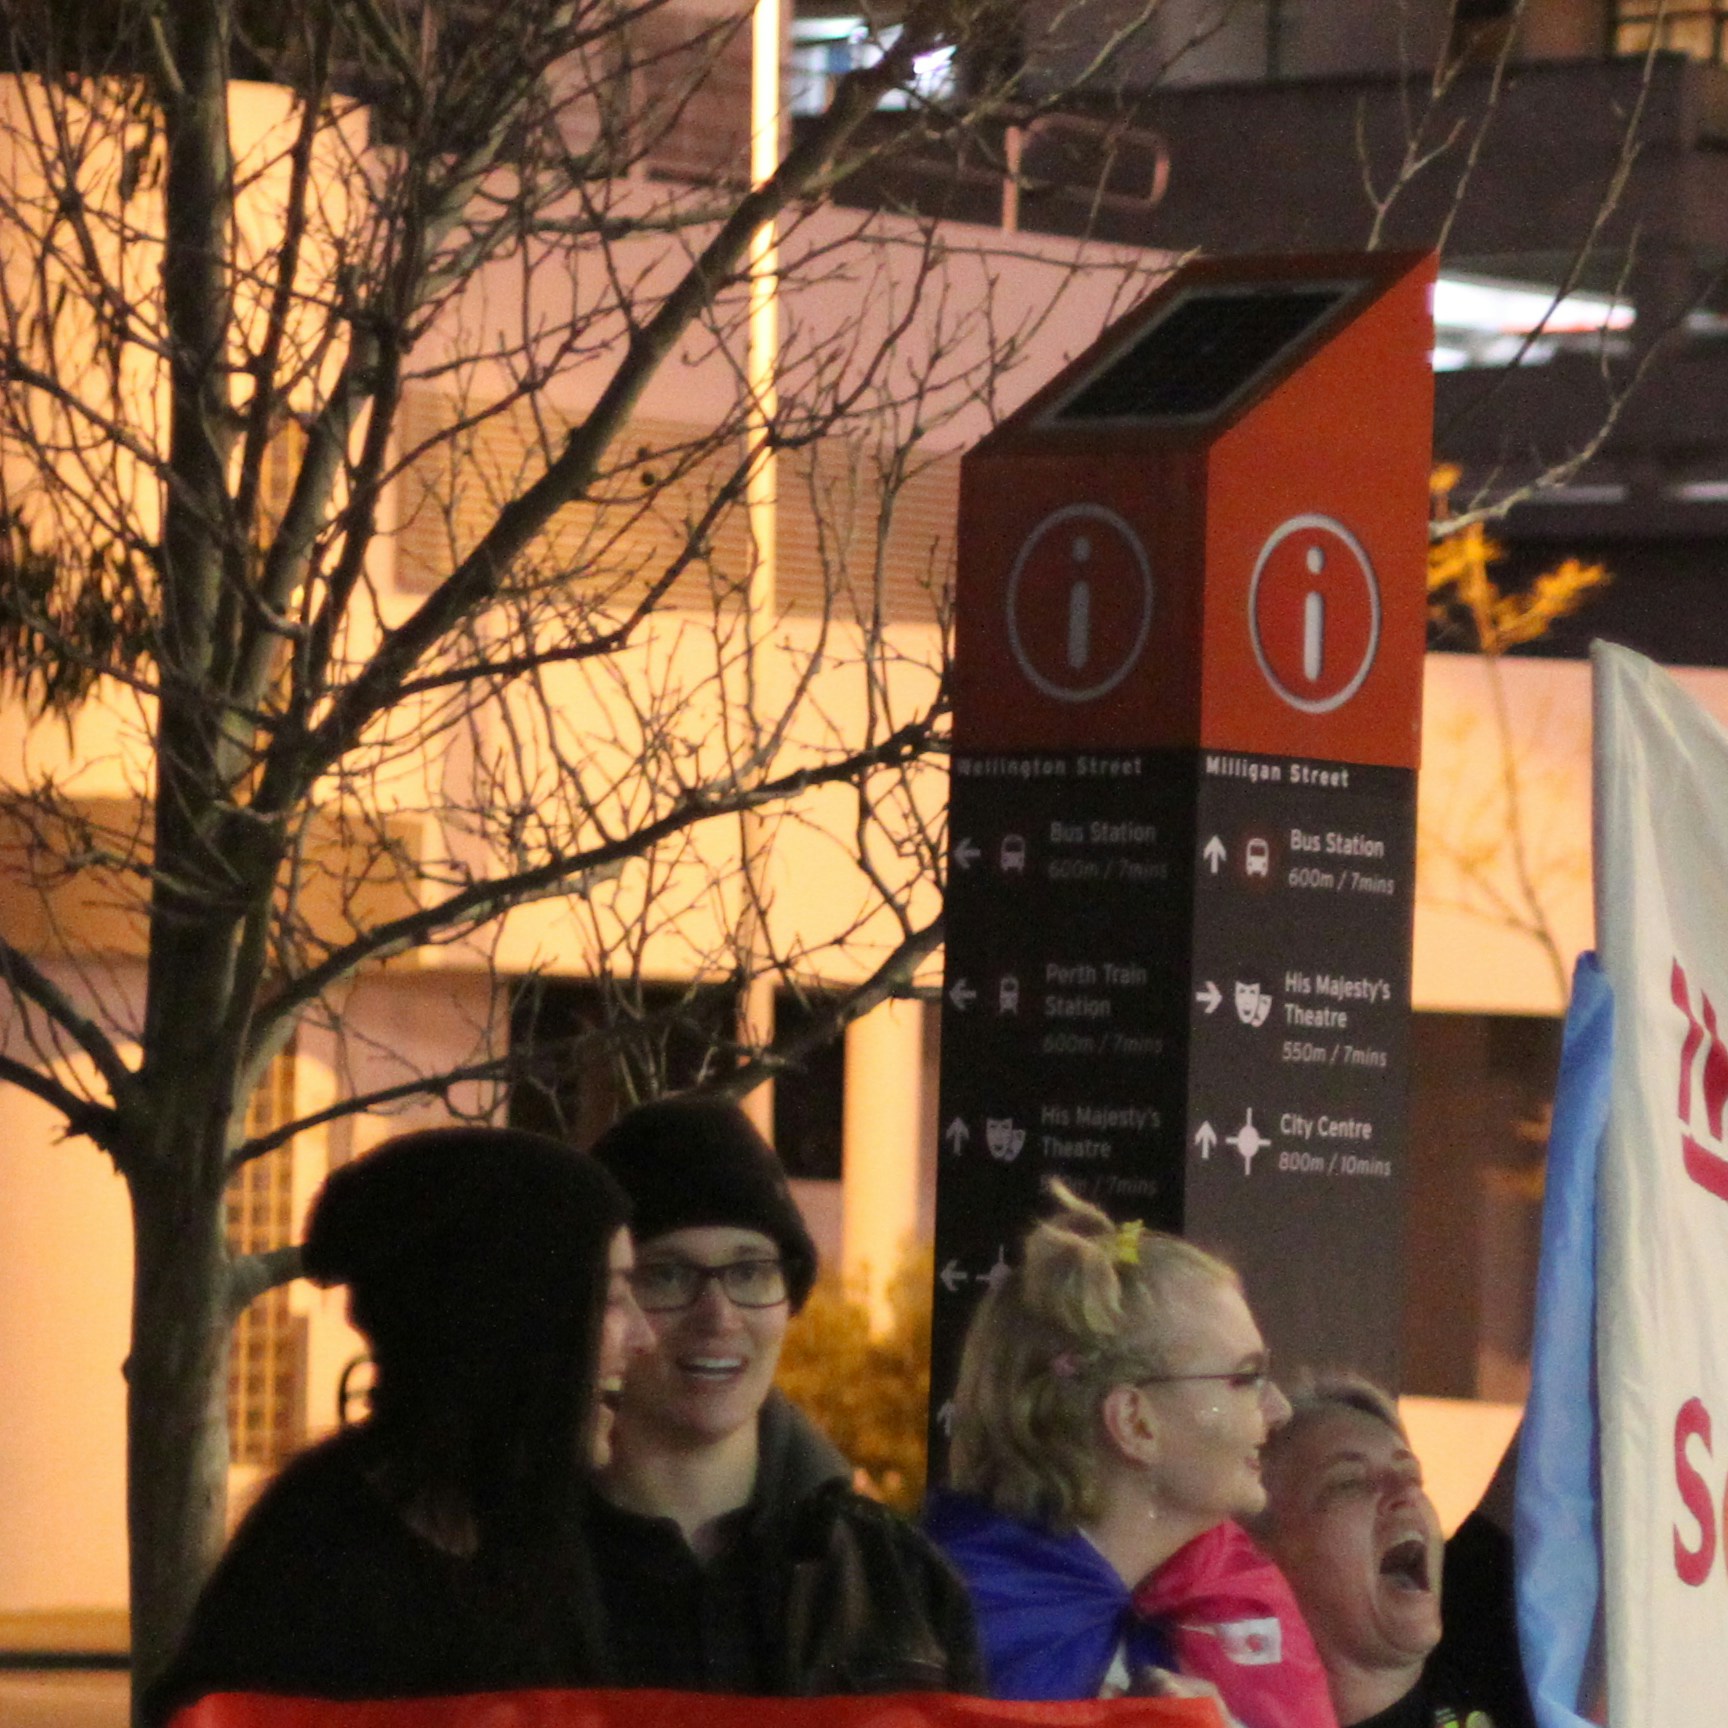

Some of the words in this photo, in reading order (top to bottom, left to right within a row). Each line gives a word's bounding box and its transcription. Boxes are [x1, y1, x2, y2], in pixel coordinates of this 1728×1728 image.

[957, 757, 1066, 780] Wellington
[1076, 755, 1142, 776] Street
[1205, 755, 1281, 784] Milligan
[1289, 763, 1350, 788] Street
[1050, 820, 1084, 843] Bus
[1090, 820, 1157, 843] Station
[1289, 828, 1321, 852] Bus
[1325, 831, 1385, 859] Station
[1288, 867, 1334, 889] 600m
[1350, 871, 1395, 895] 7mins
[1045, 962, 1097, 985] Perth
[1103, 962, 1148, 985] Train
[1284, 970, 1311, 993] His
[1316, 974, 1391, 1004] Majesty's
[1045, 995, 1111, 1017] Station
[1284, 1003, 1348, 1028] Theatre
[1282, 1041, 1326, 1063] 550m
[1343, 1045, 1387, 1068] 7mins
[1041, 1105, 1070, 1127] His
[1076, 1105, 1161, 1131] Majesty's
[1280, 1113, 1314, 1140] City
[1317, 1115, 1373, 1140] Centre
[1042, 1135, 1112, 1158] Theatre
[1278, 1152, 1325, 1172] 800m
[1341, 1155, 1392, 1177] 10mins
